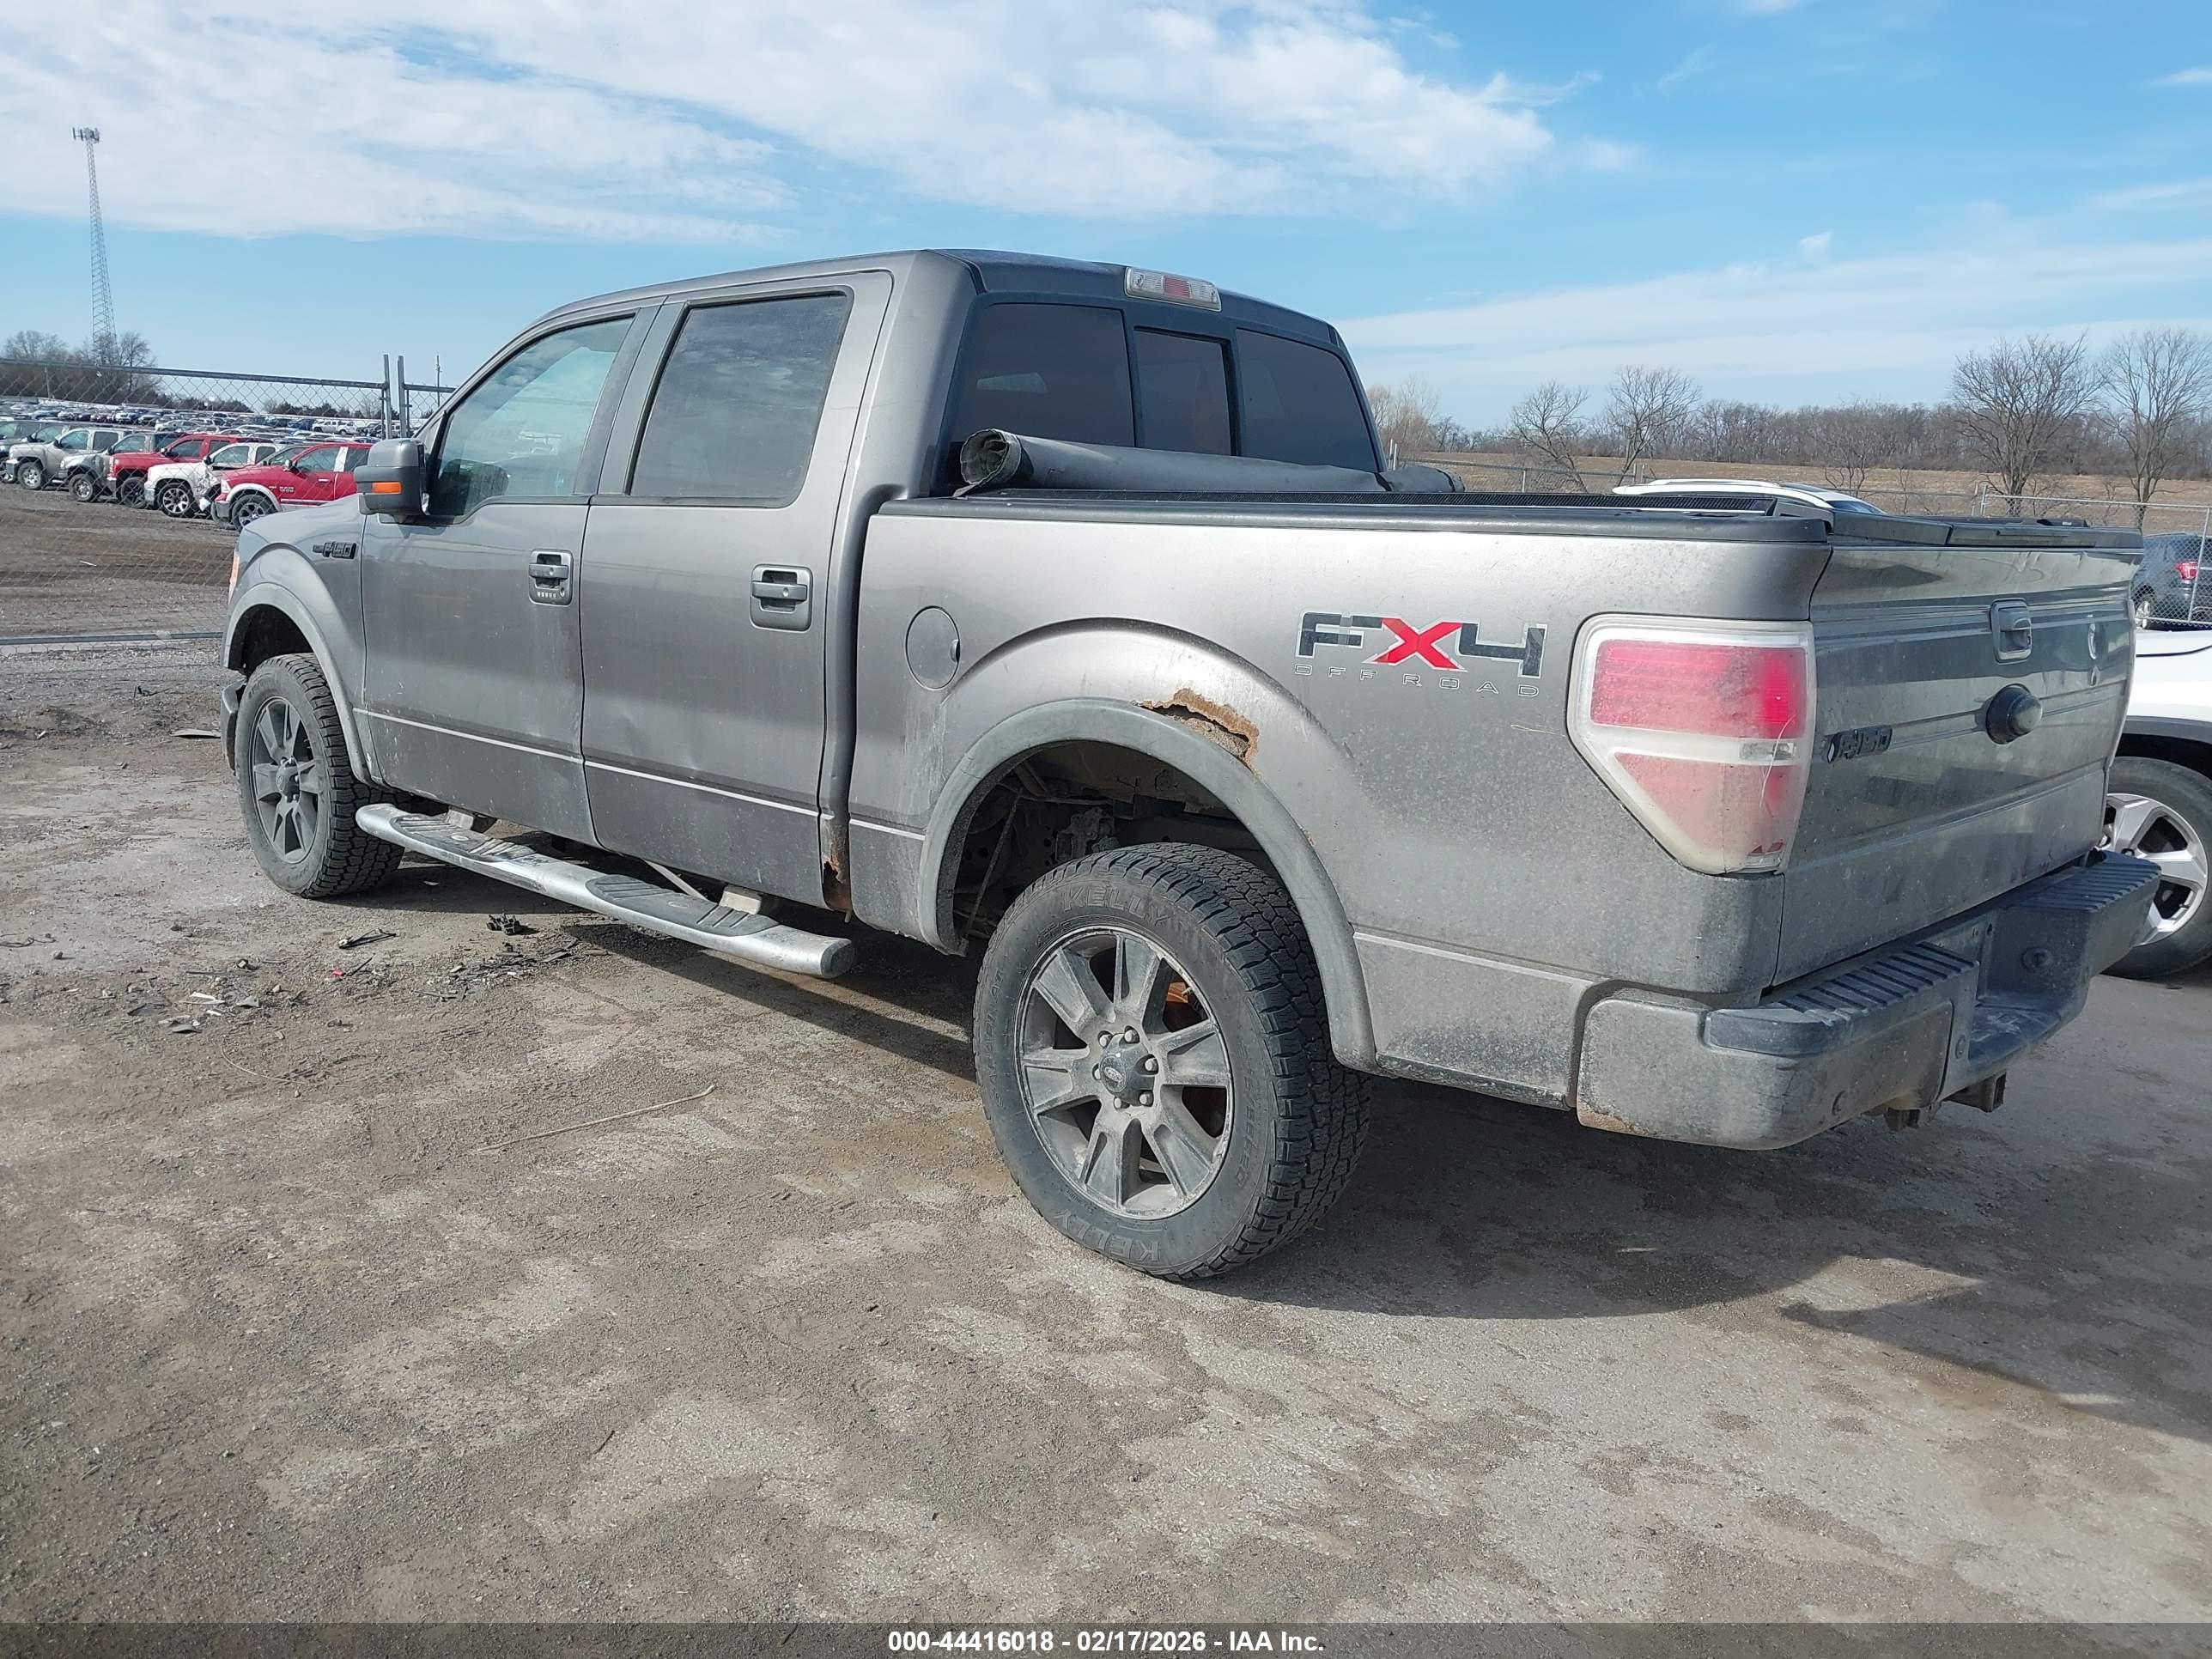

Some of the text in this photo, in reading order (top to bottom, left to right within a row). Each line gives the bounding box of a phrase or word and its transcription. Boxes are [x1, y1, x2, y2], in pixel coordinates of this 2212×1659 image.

[1296, 611, 1548, 679] FX4
[1294, 663, 1540, 697] OFF ROAD
[1061, 886, 1170, 927] KELLY
[1050, 1208, 1161, 1262] KELLY
